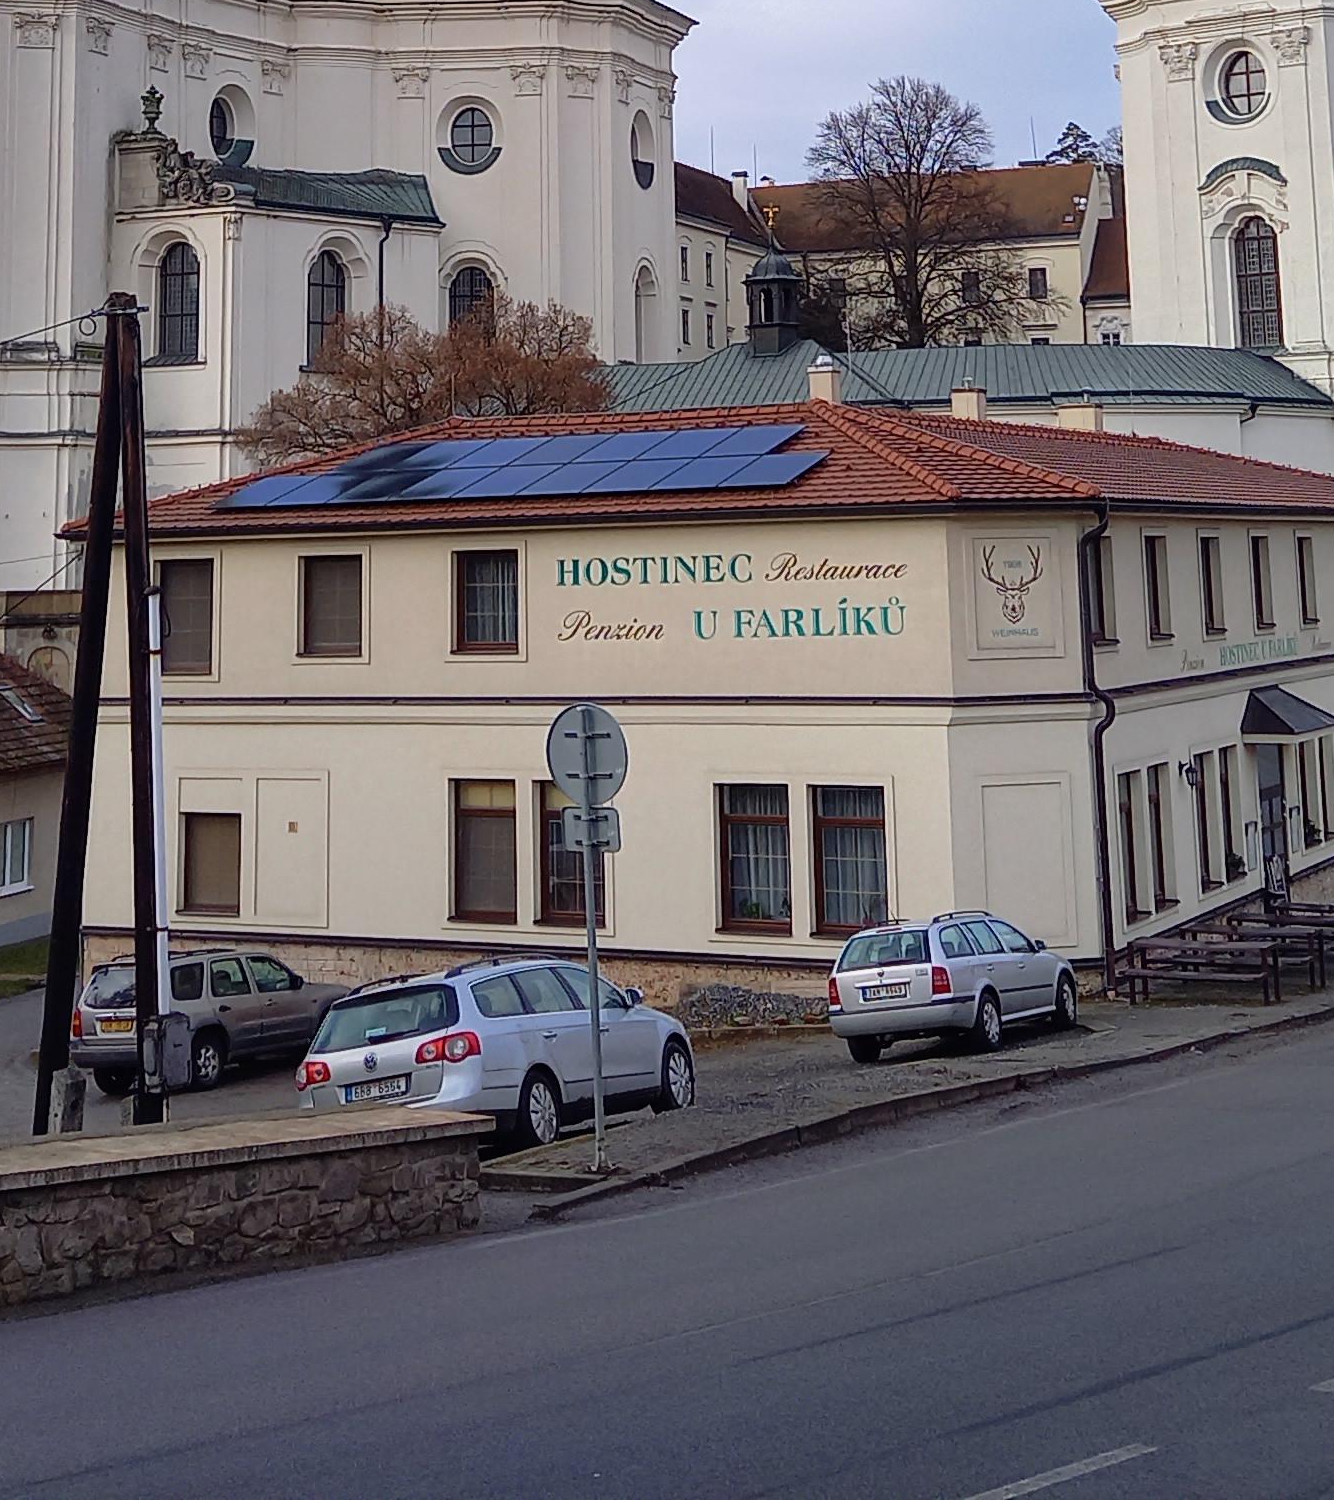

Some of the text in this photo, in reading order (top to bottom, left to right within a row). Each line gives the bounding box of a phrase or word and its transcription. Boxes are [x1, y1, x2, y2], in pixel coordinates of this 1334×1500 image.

[555, 551, 908, 587] HOSTINEC Restaurace
[556, 595, 907, 642] Penzion U FARLÍKŮ
